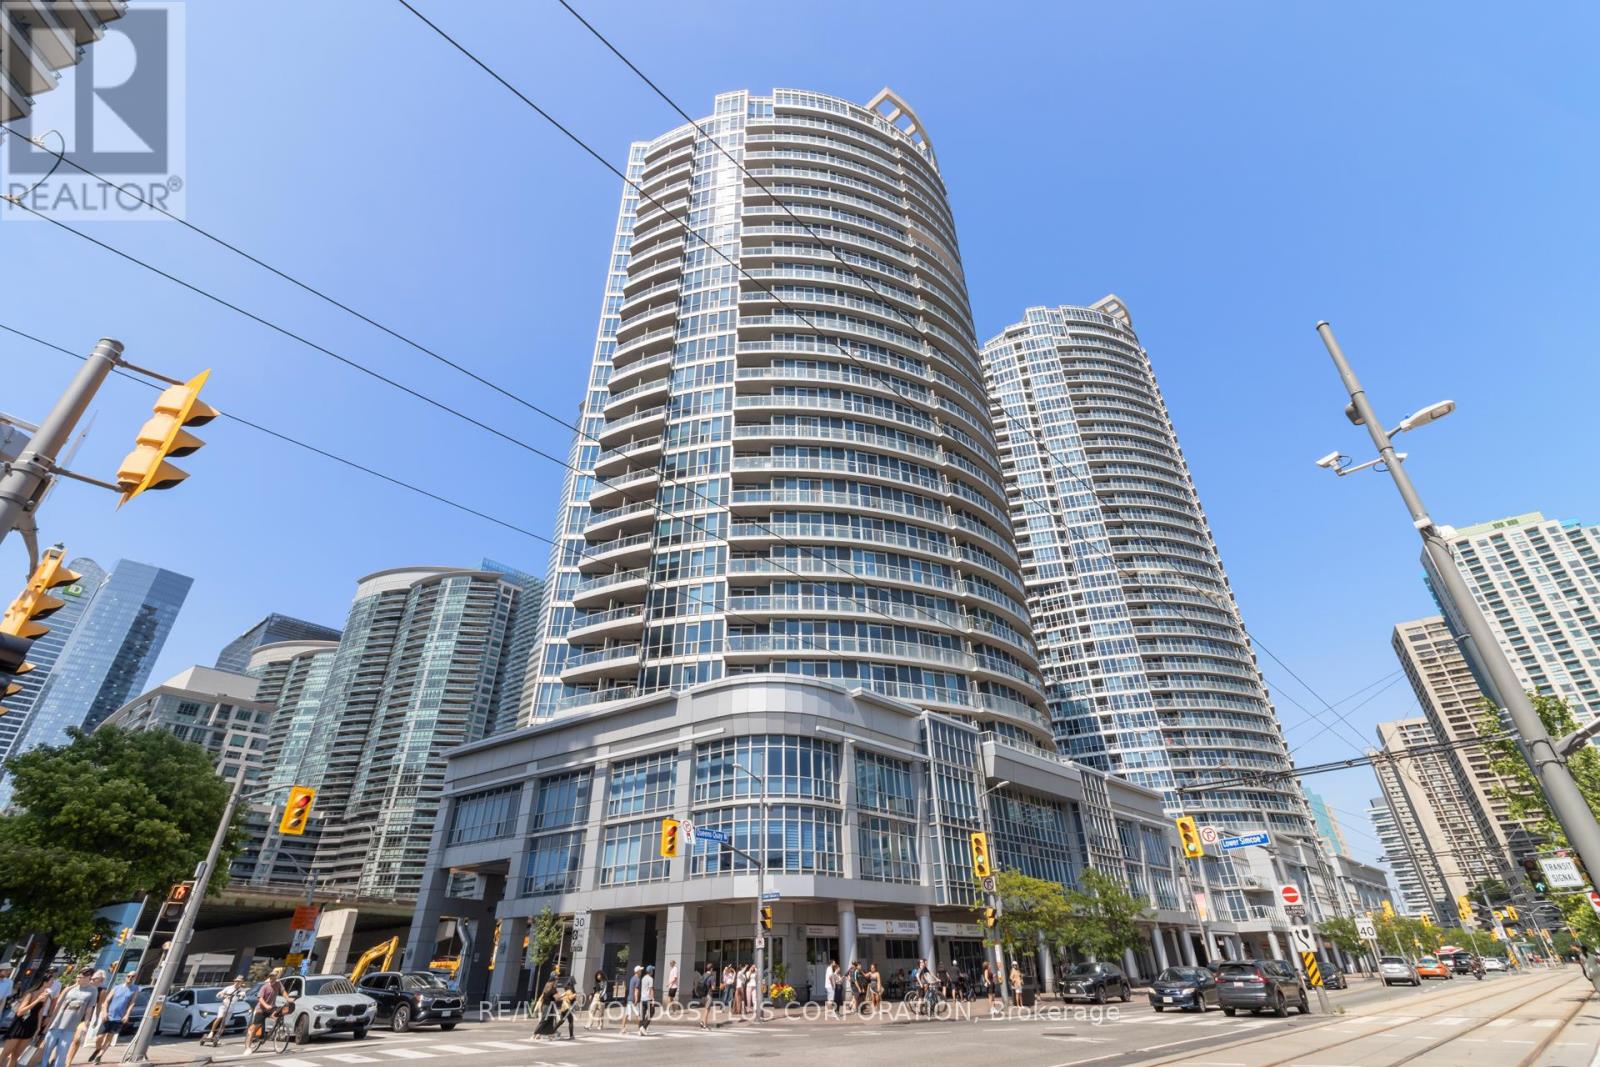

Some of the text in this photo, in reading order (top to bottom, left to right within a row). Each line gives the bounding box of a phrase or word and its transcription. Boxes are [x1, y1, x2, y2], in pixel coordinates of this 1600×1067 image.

[696, 829, 712, 839] Queens
[713, 831, 723, 841] Quay
[1223, 839, 1239, 849] Lower
[1239, 835, 1261, 846] Simcoe
[1545, 861, 1574, 871] TRANSIT
[1552, 872, 1578, 882] SIGNAL
[575, 917, 585, 927] 30
[1359, 926, 1375, 937] 40
